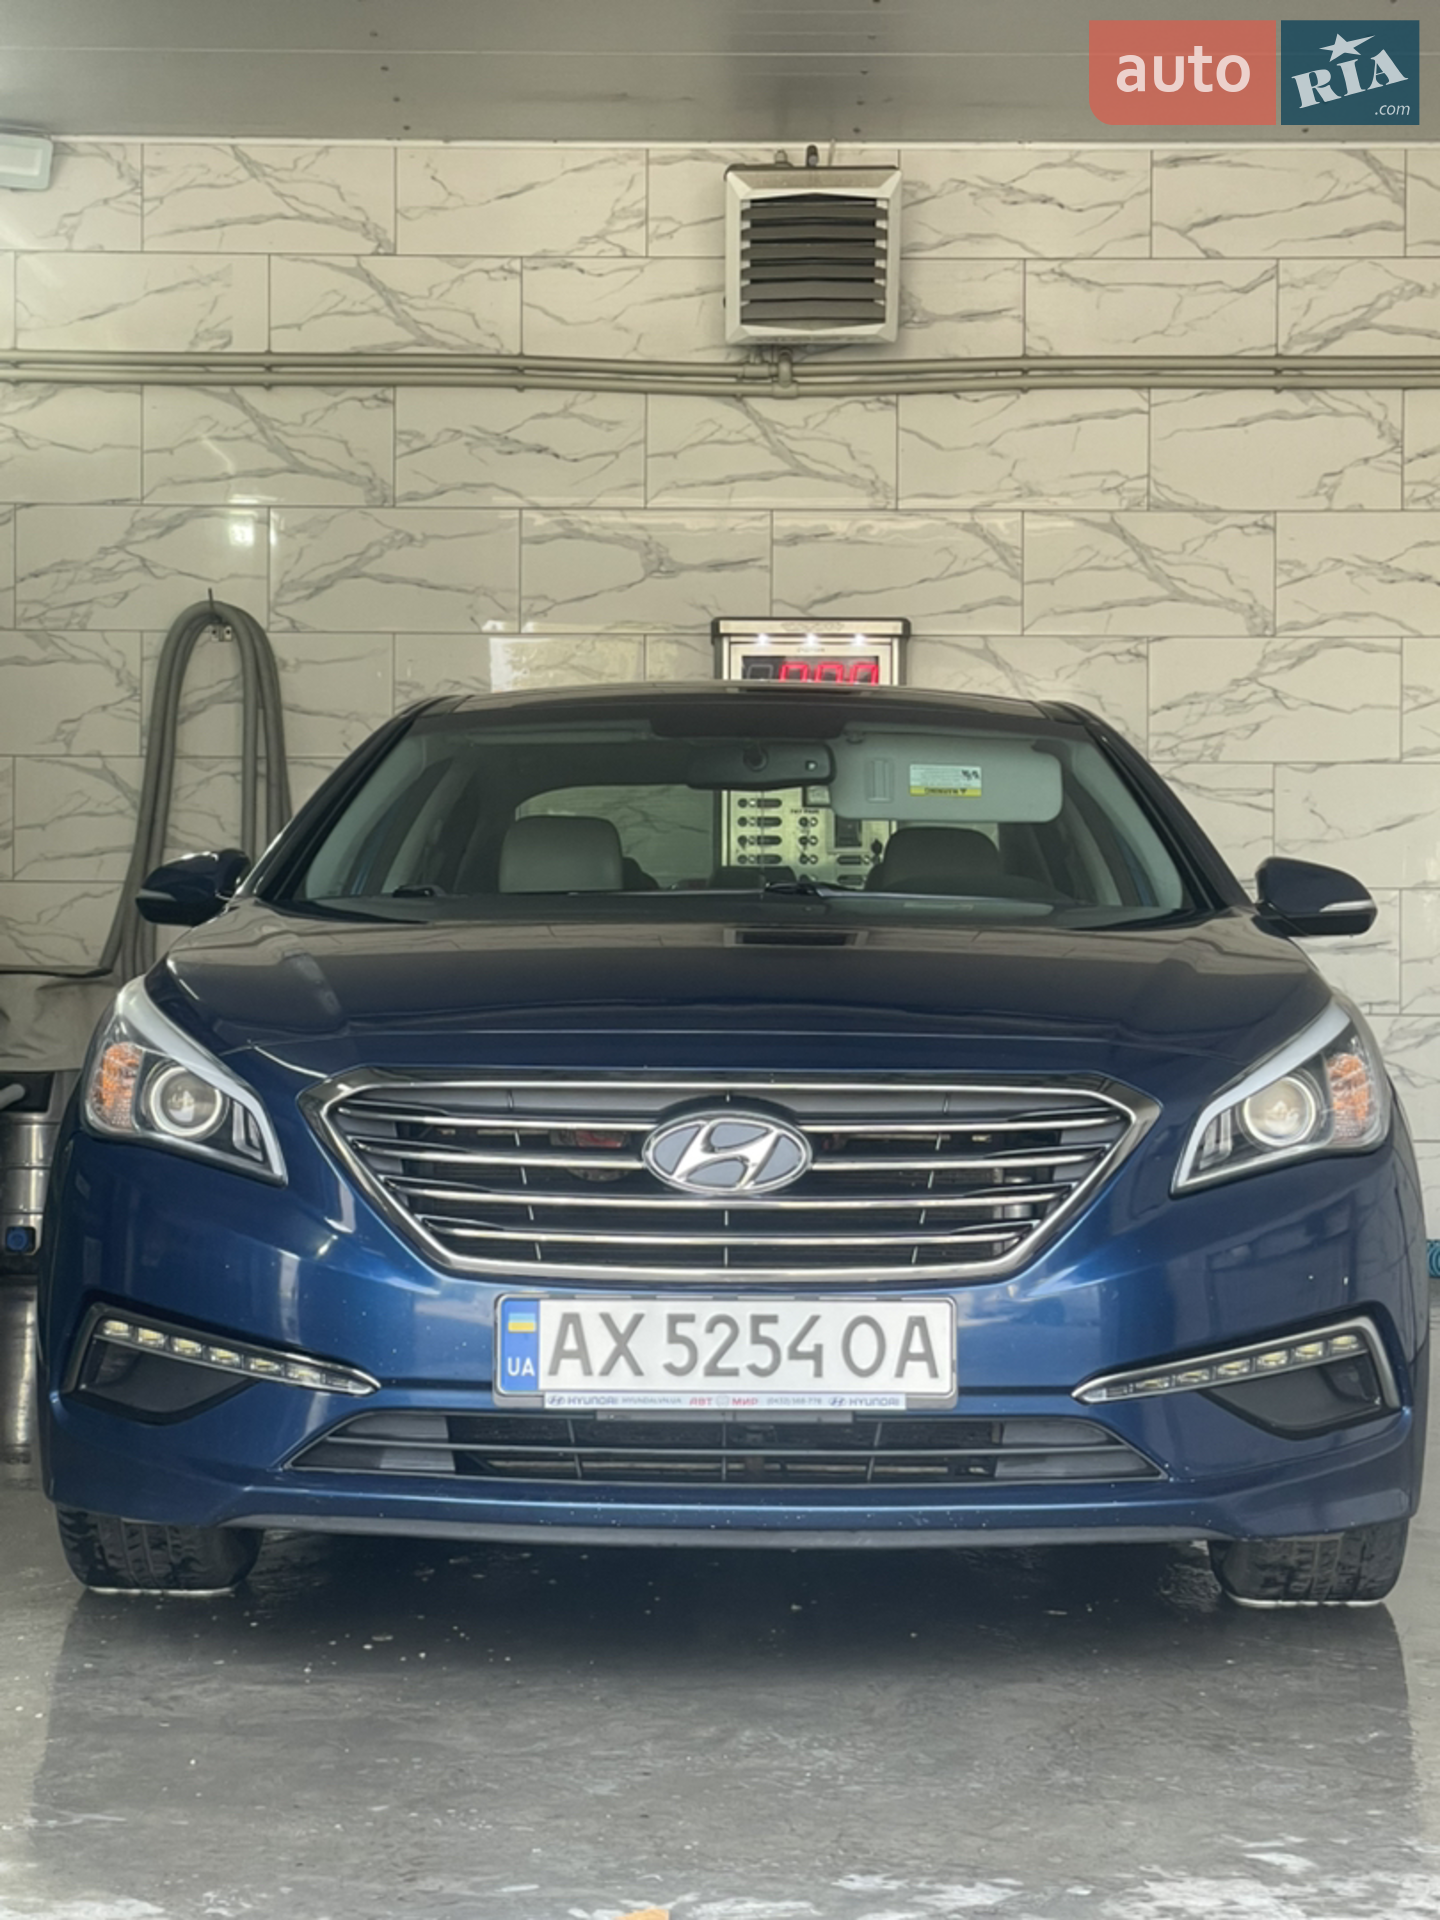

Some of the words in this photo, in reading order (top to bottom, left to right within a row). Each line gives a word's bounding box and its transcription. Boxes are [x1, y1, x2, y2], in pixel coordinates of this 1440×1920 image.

[548, 1312, 645, 1377] AX
[662, 1313, 824, 1378] 5254
[841, 1315, 940, 1379] OA
[507, 1358, 535, 1376] UA
[567, 1395, 619, 1405] HYUNDAI
[849, 1396, 900, 1406] HYUNDAI
